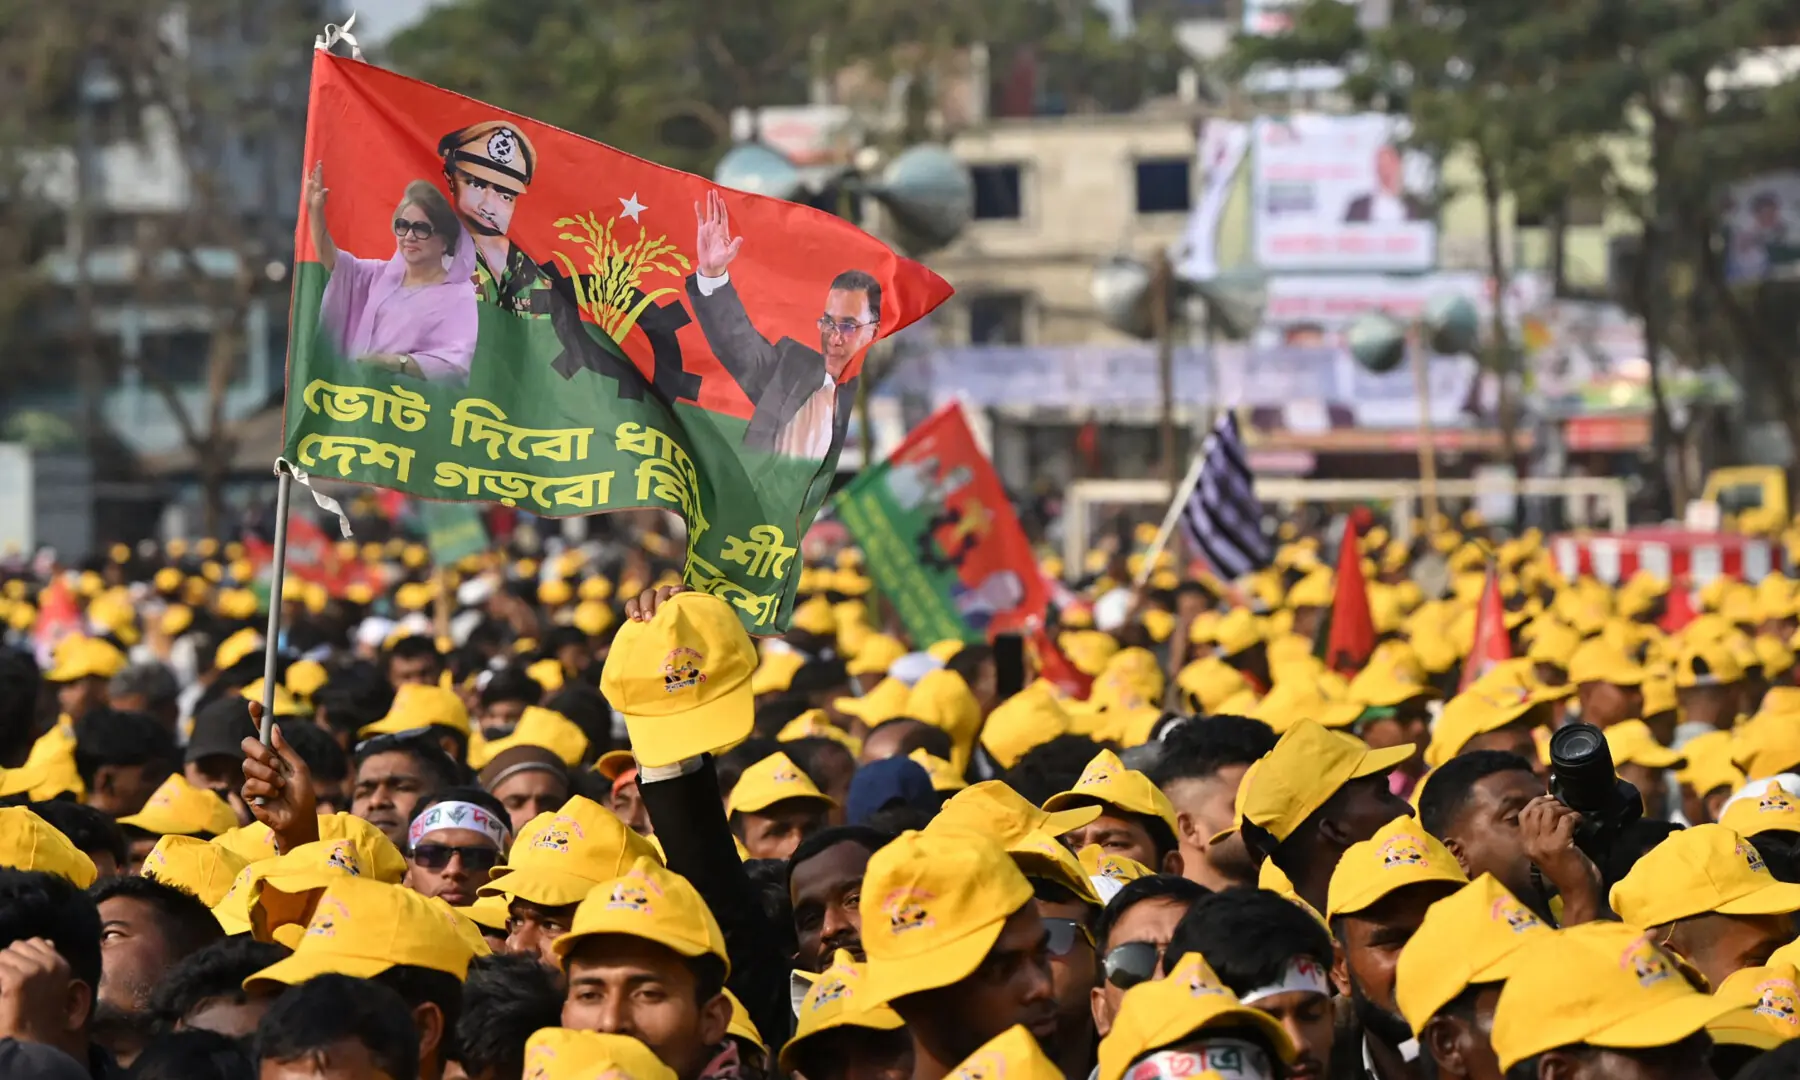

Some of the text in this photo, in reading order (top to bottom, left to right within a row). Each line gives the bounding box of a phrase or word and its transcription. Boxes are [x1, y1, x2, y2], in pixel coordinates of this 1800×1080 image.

[297, 432, 416, 483] দেশ
[433, 461, 615, 509] গড়বো
[303, 378, 431, 432] ভোট
[450, 398, 595, 462] দিবো
[720, 524, 798, 580] শীে
